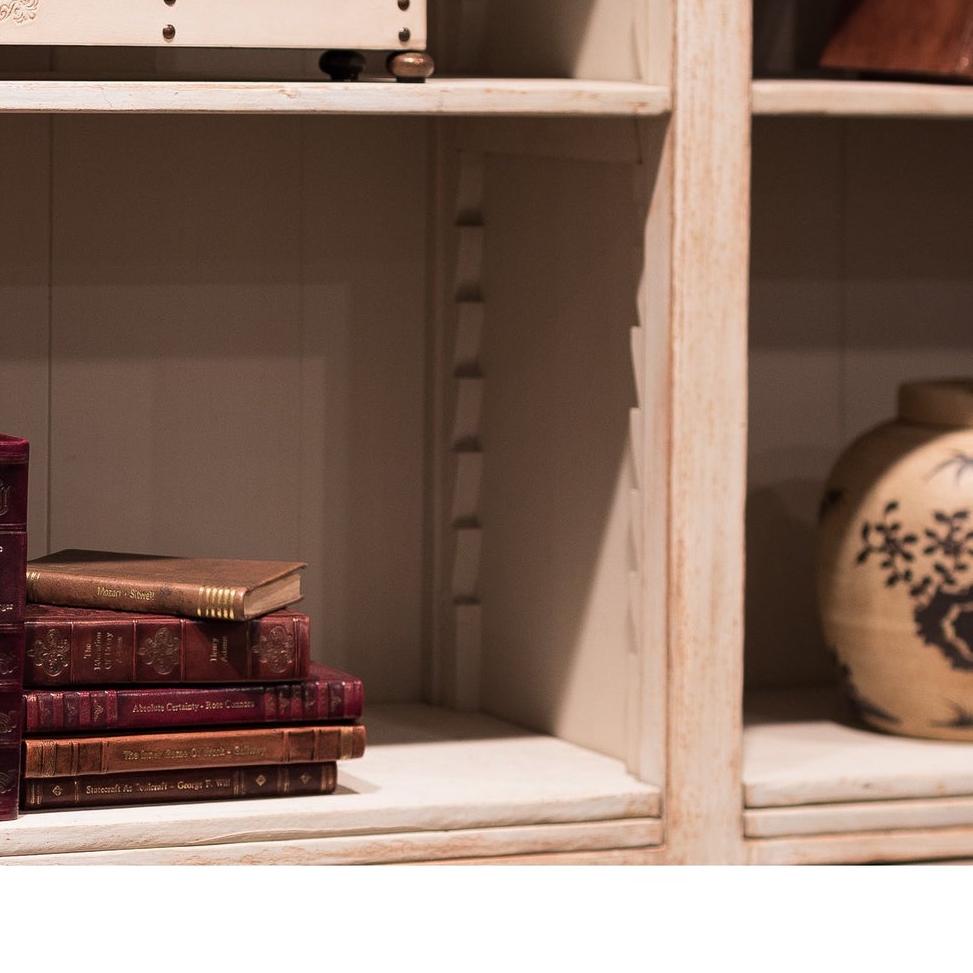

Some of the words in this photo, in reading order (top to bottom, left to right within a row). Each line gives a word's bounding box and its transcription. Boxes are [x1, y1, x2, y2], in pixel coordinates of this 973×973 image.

[132, 703, 165, 713] Absolute
[166, 701, 200, 712] Certainty
[123, 749, 138, 760] The
[177, 780, 203, 791] George
